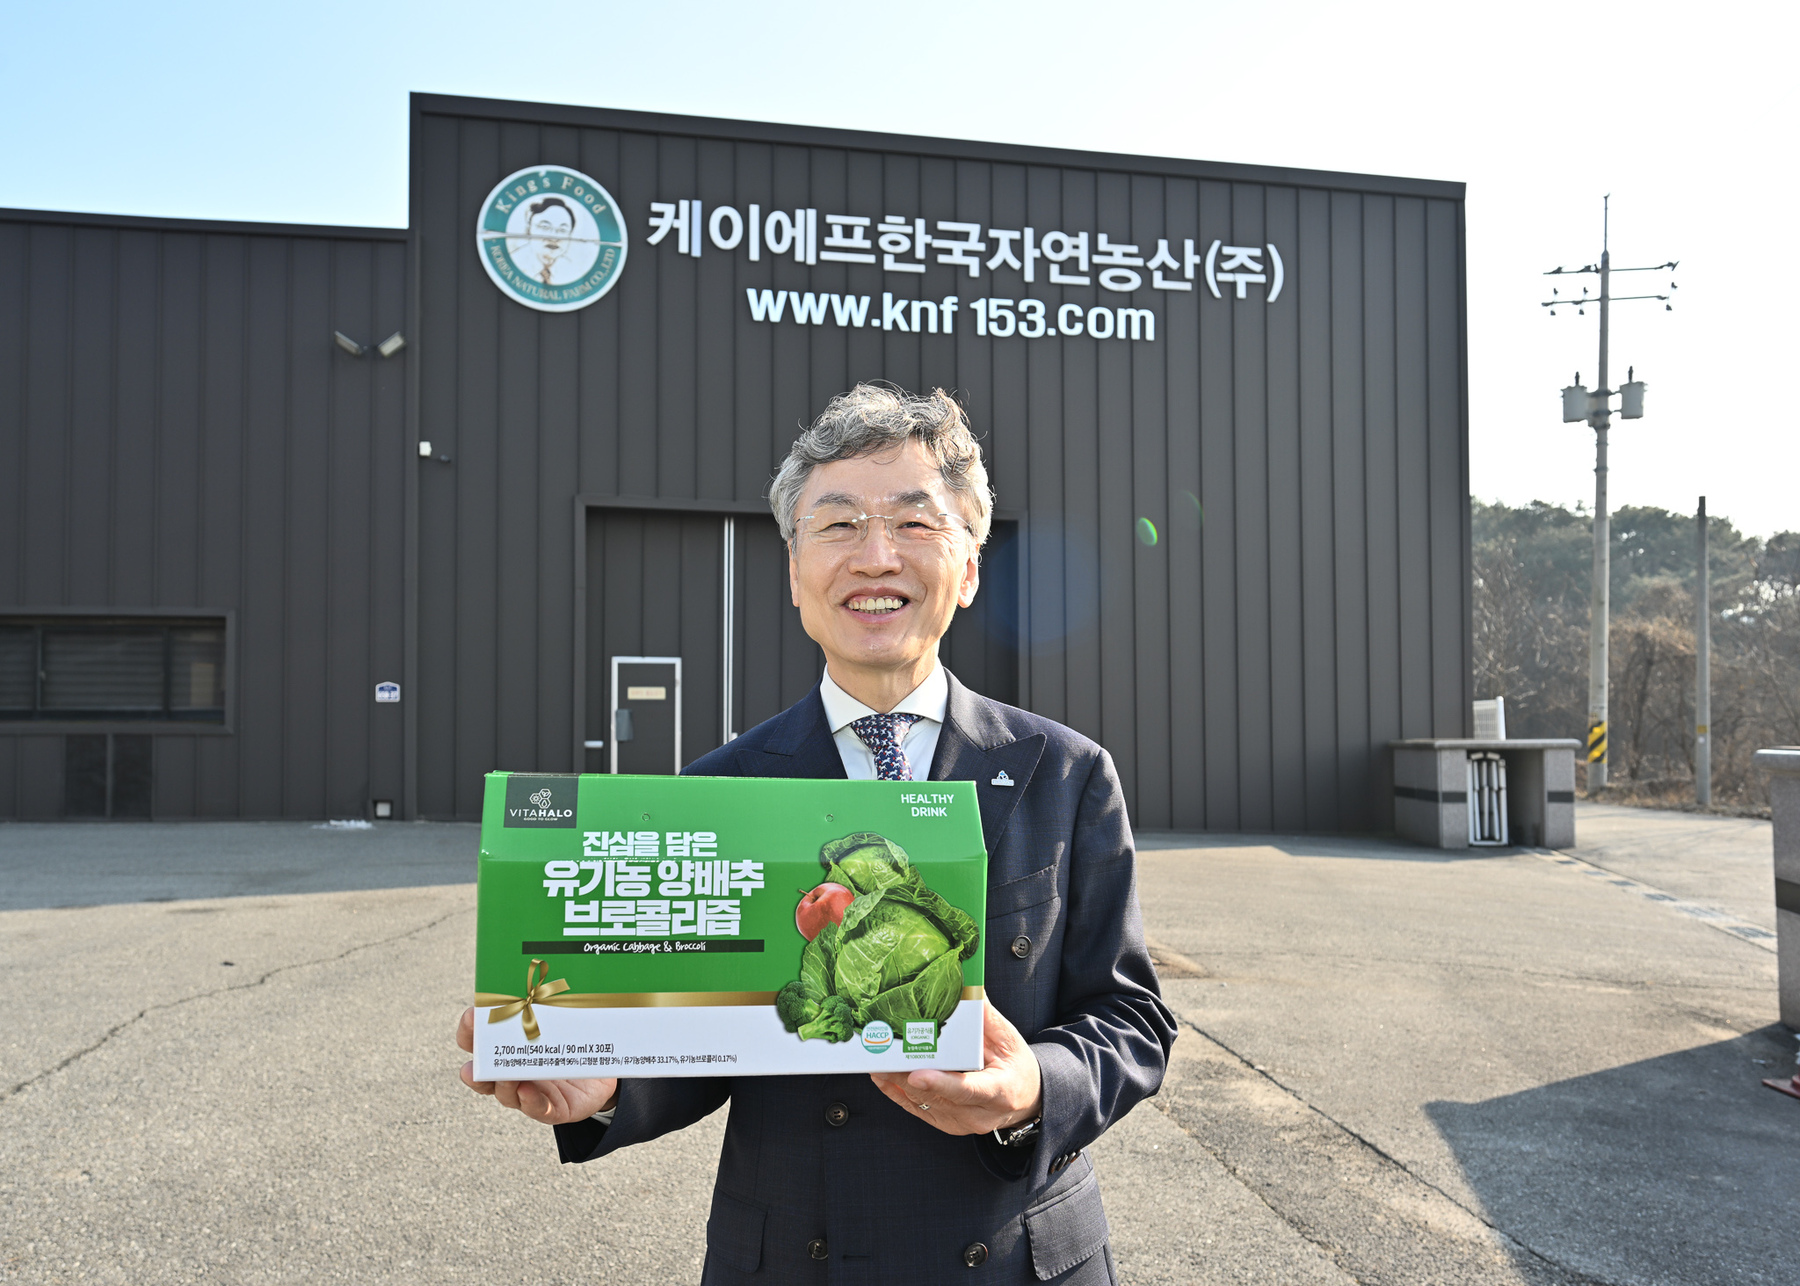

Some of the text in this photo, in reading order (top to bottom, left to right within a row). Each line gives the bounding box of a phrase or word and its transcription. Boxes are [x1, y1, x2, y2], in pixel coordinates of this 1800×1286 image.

[495, 170, 607, 215] King's Food
[646, 199, 1285, 303] 케이에프한국자연농산(주)
[900, 793, 954, 804] HEALTHY
[509, 808, 573, 818] VITAHALO
[911, 806, 948, 817] DRINK
[582, 831, 718, 857] 진심을 담은
[543, 859, 765, 897] 유기농 양배추
[563, 900, 741, 936] 브로콜리즙
[583, 941, 706, 955] Organic Cabbage & Broccoli
[494, 1045, 515, 1056] 2,700
[544, 1044, 561, 1054] kcal
[561, 1044, 566, 1055] /
[566, 1044, 576, 1054] 90
[577, 1043, 588, 1054] ml
[595, 1043, 615, 1055] 30포)
